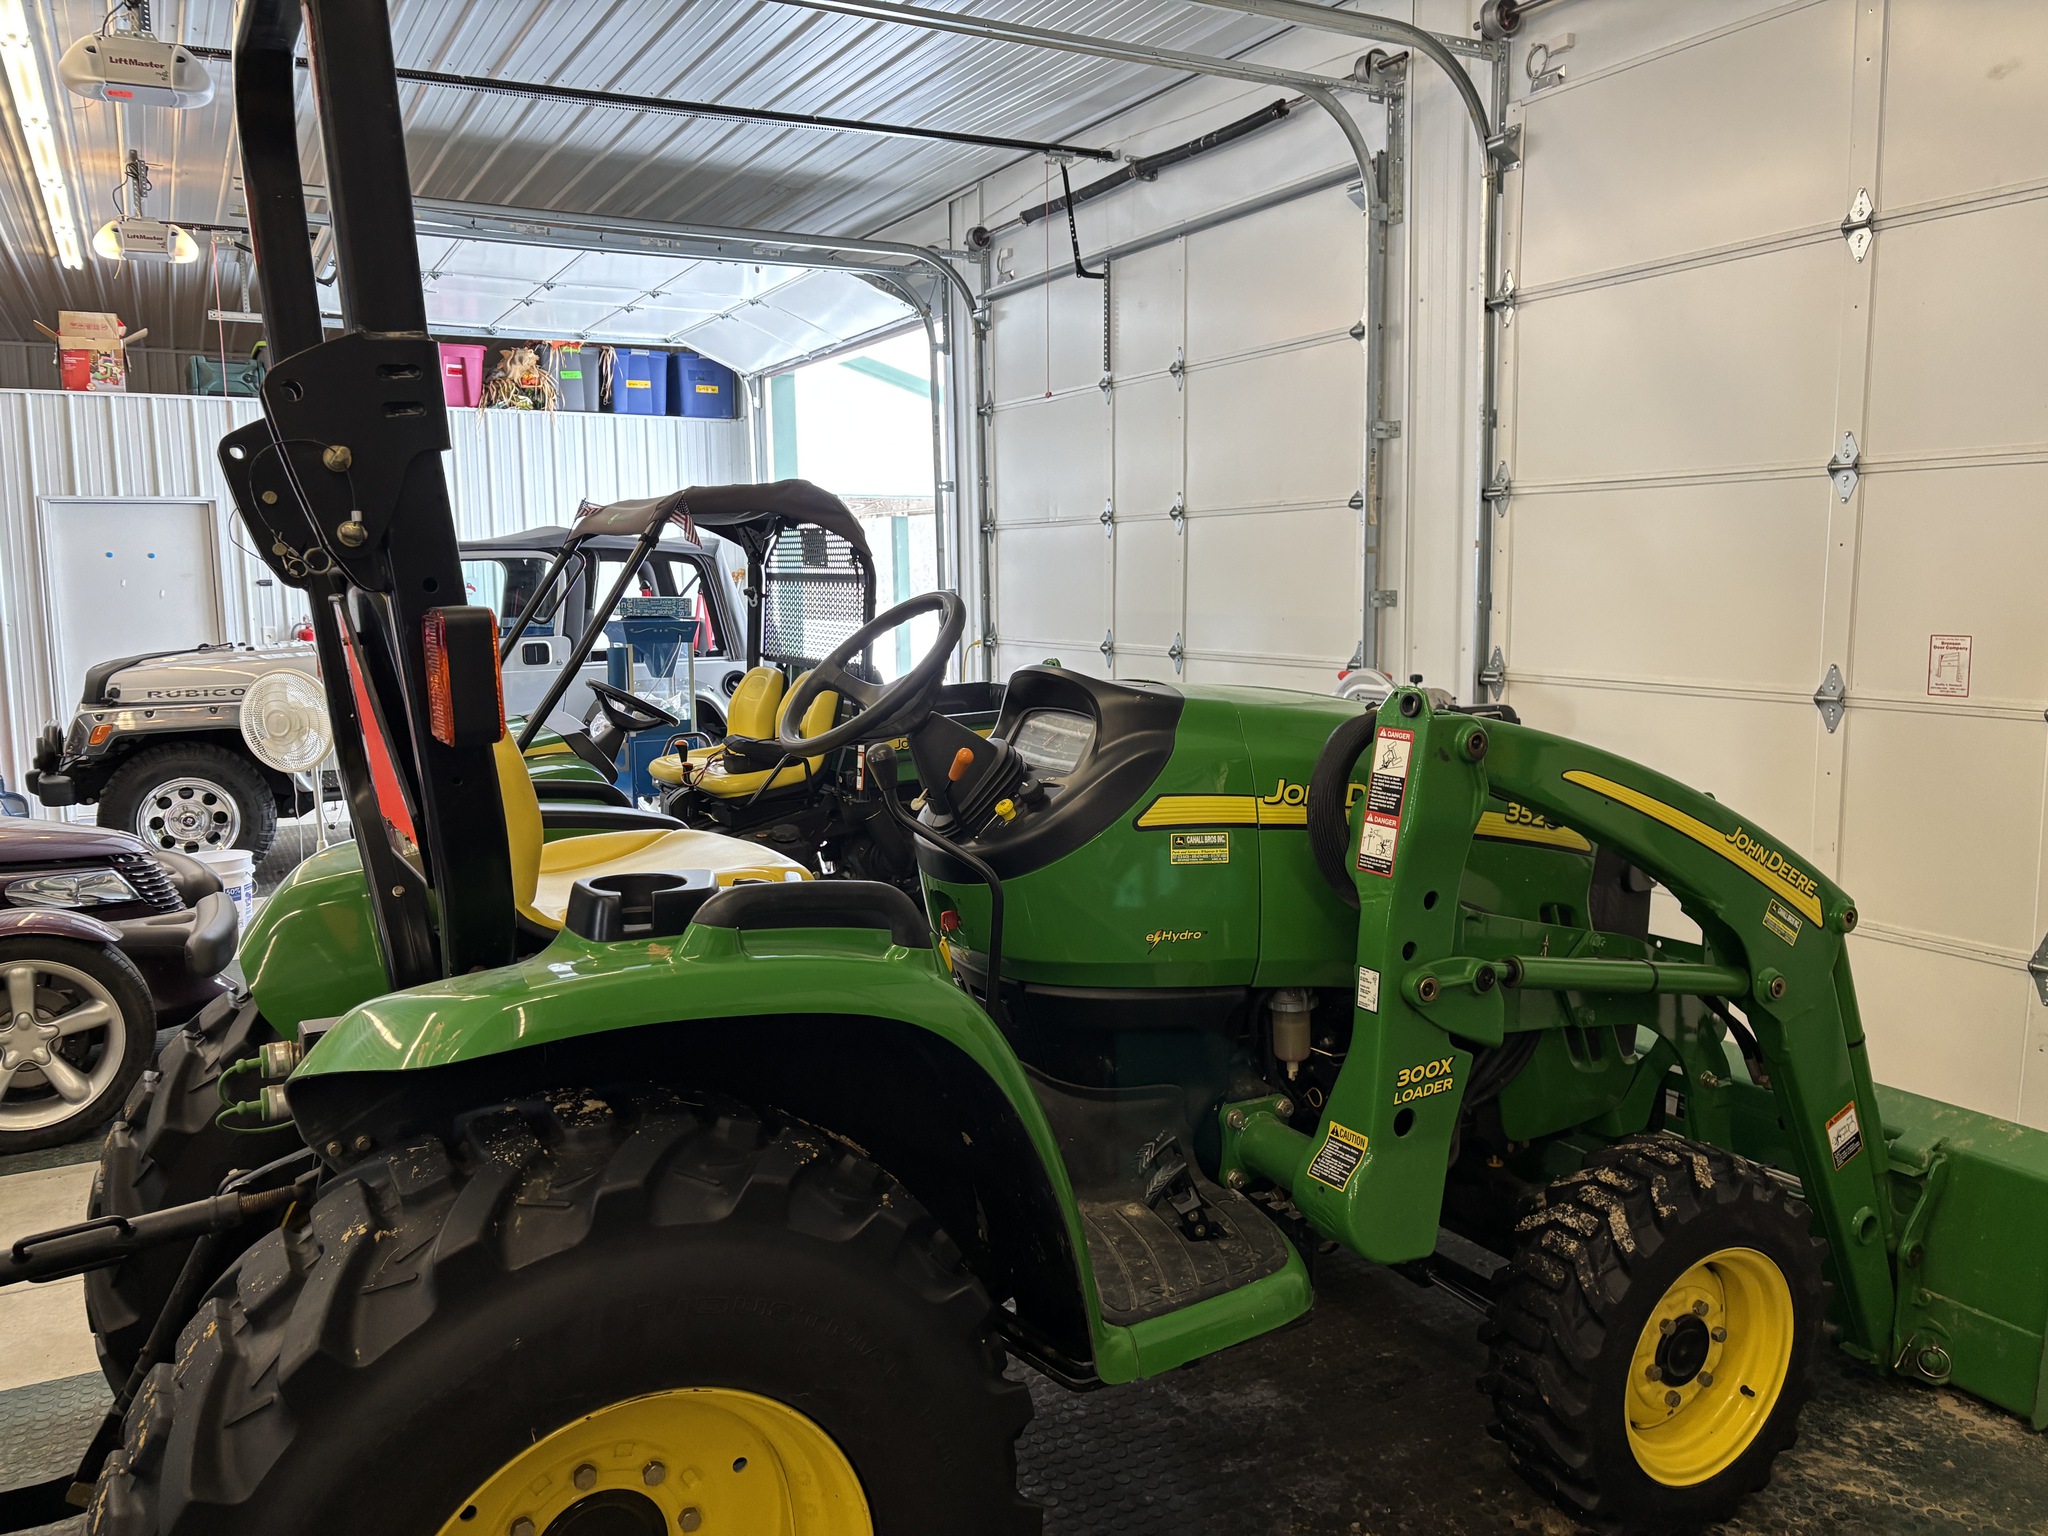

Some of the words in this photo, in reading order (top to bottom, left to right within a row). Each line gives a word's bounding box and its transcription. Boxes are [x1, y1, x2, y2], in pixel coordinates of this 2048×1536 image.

[109, 56, 165, 69] LiftMaster
[126, 233, 164, 241] LiftMaster
[147, 687, 246, 699] RUBICO
[1387, 730, 1410, 740] DANGER
[1373, 817, 1397, 827] DANGER
[1505, 801, 1559, 830] 352
[1186, 836, 1204, 844] CAHALL
[1725, 826, 1769, 864] JOHN
[1766, 850, 1818, 897] DEERE
[1397, 1056, 1455, 1087] 300X
[1393, 1077, 1454, 1105] LOADER
[1339, 1128, 1366, 1148] CAUTION
